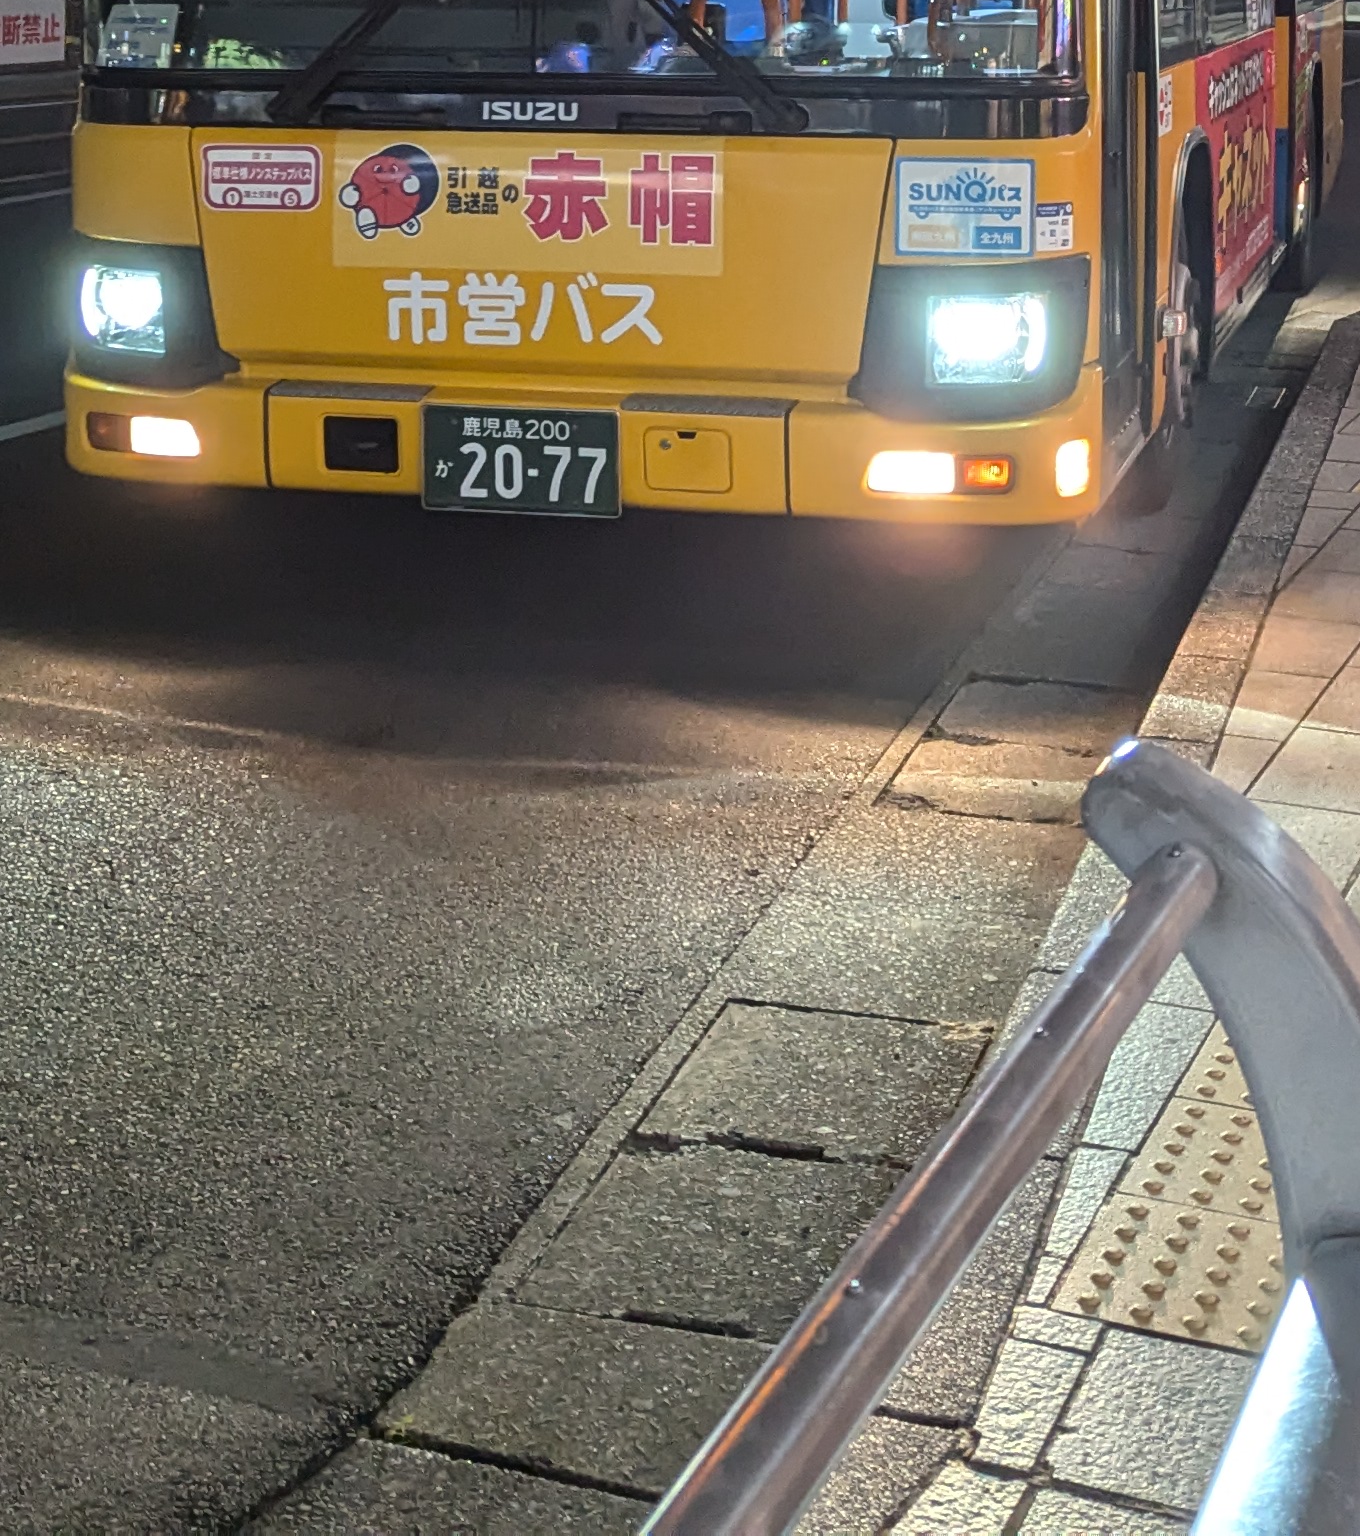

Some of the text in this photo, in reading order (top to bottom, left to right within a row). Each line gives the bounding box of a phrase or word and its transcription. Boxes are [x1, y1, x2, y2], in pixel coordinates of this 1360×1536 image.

[482, 101, 580, 122] ISUZU
[446, 166, 500, 188] 引越
[446, 193, 499, 215] 急送品
[501, 184, 520, 204] の
[522, 150, 716, 247] 赤帽
[980, 232, 1014, 245] 全九州
[383, 271, 664, 346] 市営バス
[435, 442, 607, 504] か 20-77
